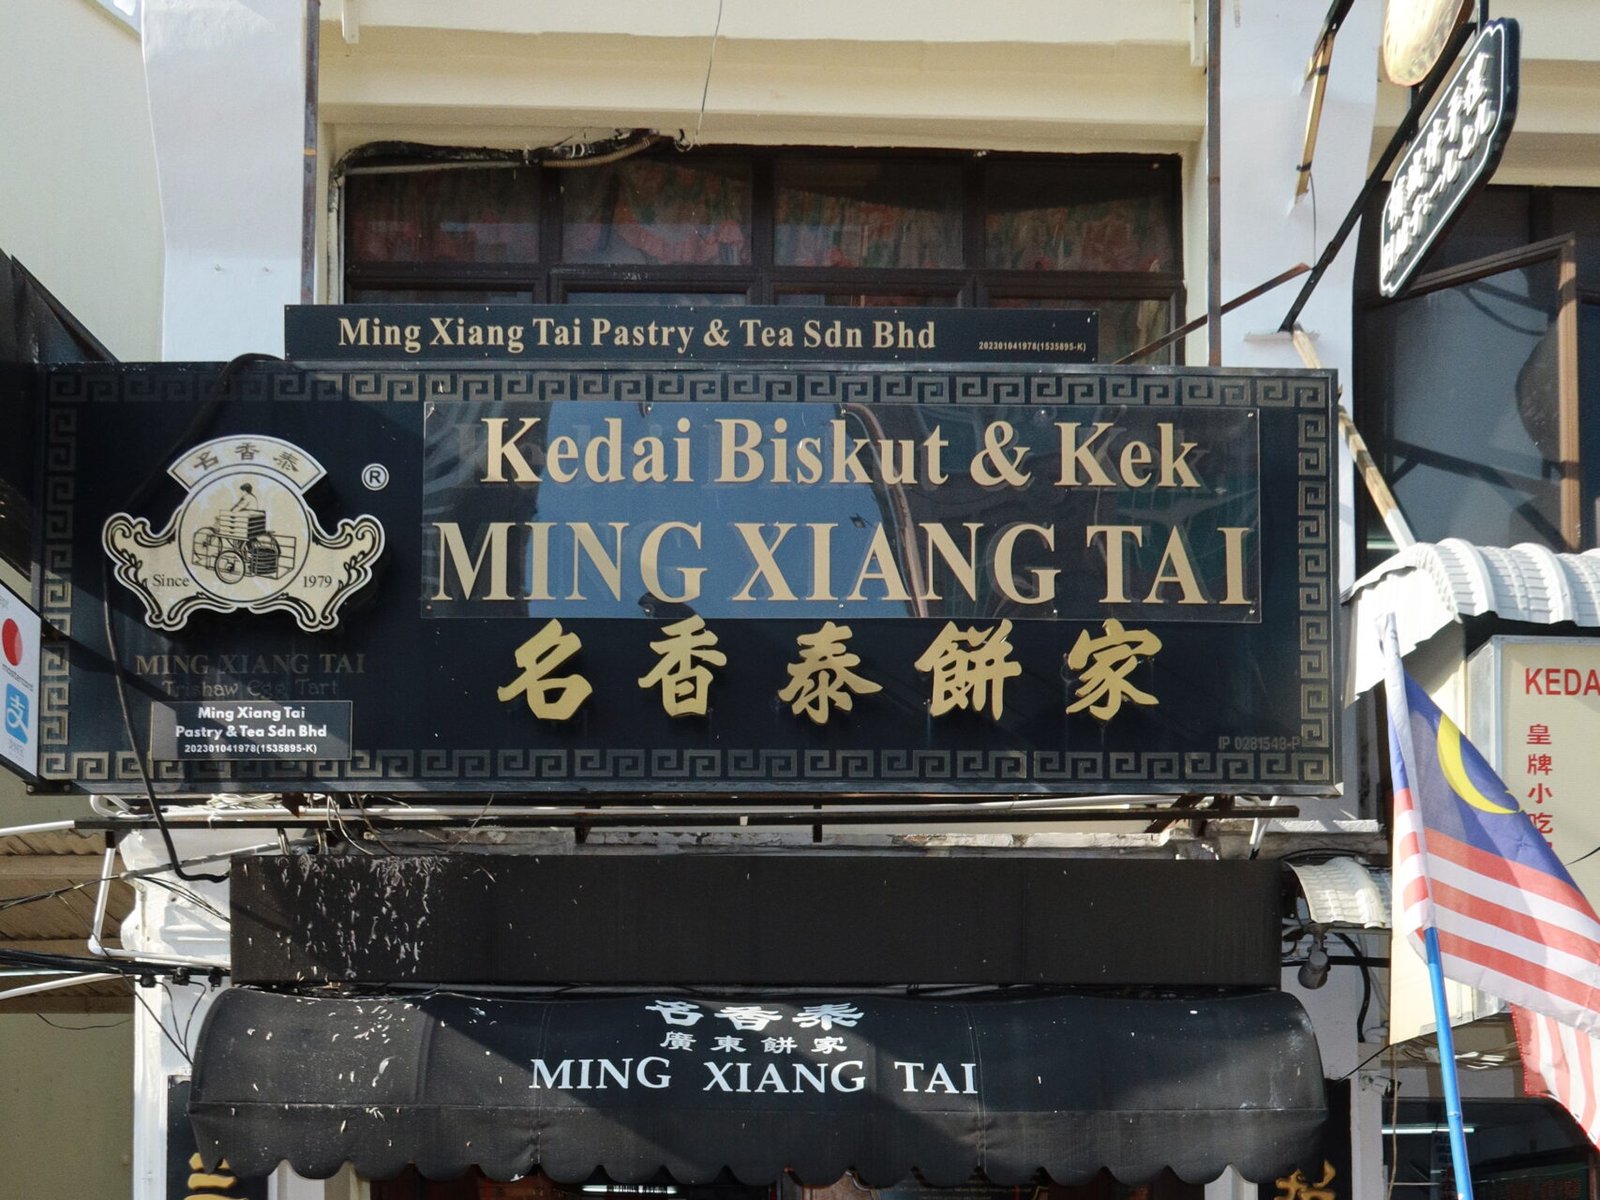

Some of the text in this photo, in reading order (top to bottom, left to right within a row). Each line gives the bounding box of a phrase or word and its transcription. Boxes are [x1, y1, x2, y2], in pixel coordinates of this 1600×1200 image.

[338, 317, 936, 354] Ming Xiang Tai Pastry & Tea Sdn Bhd
[480, 416, 1201, 488] Kedai Biskut & Kek
[431, 520, 1254, 606] MING XIANG TAI
[152, 573, 333, 589] Since 1979
[136, 653, 366, 676] MING XIANG TAI
[497, 617, 1163, 725] 名香泰餅家
[198, 706, 306, 722] Ming Xiang Tai
[176, 725, 327, 741] Pastry & Tea Sdn Bhd
[184, 743, 318, 755] 202301041978(1535895-K)
[1526, 723, 1554, 850] 皇牌小吃
[659, 1031, 848, 1055] 廣東餅家
[528, 1056, 978, 1095] MING XIANG TAI
